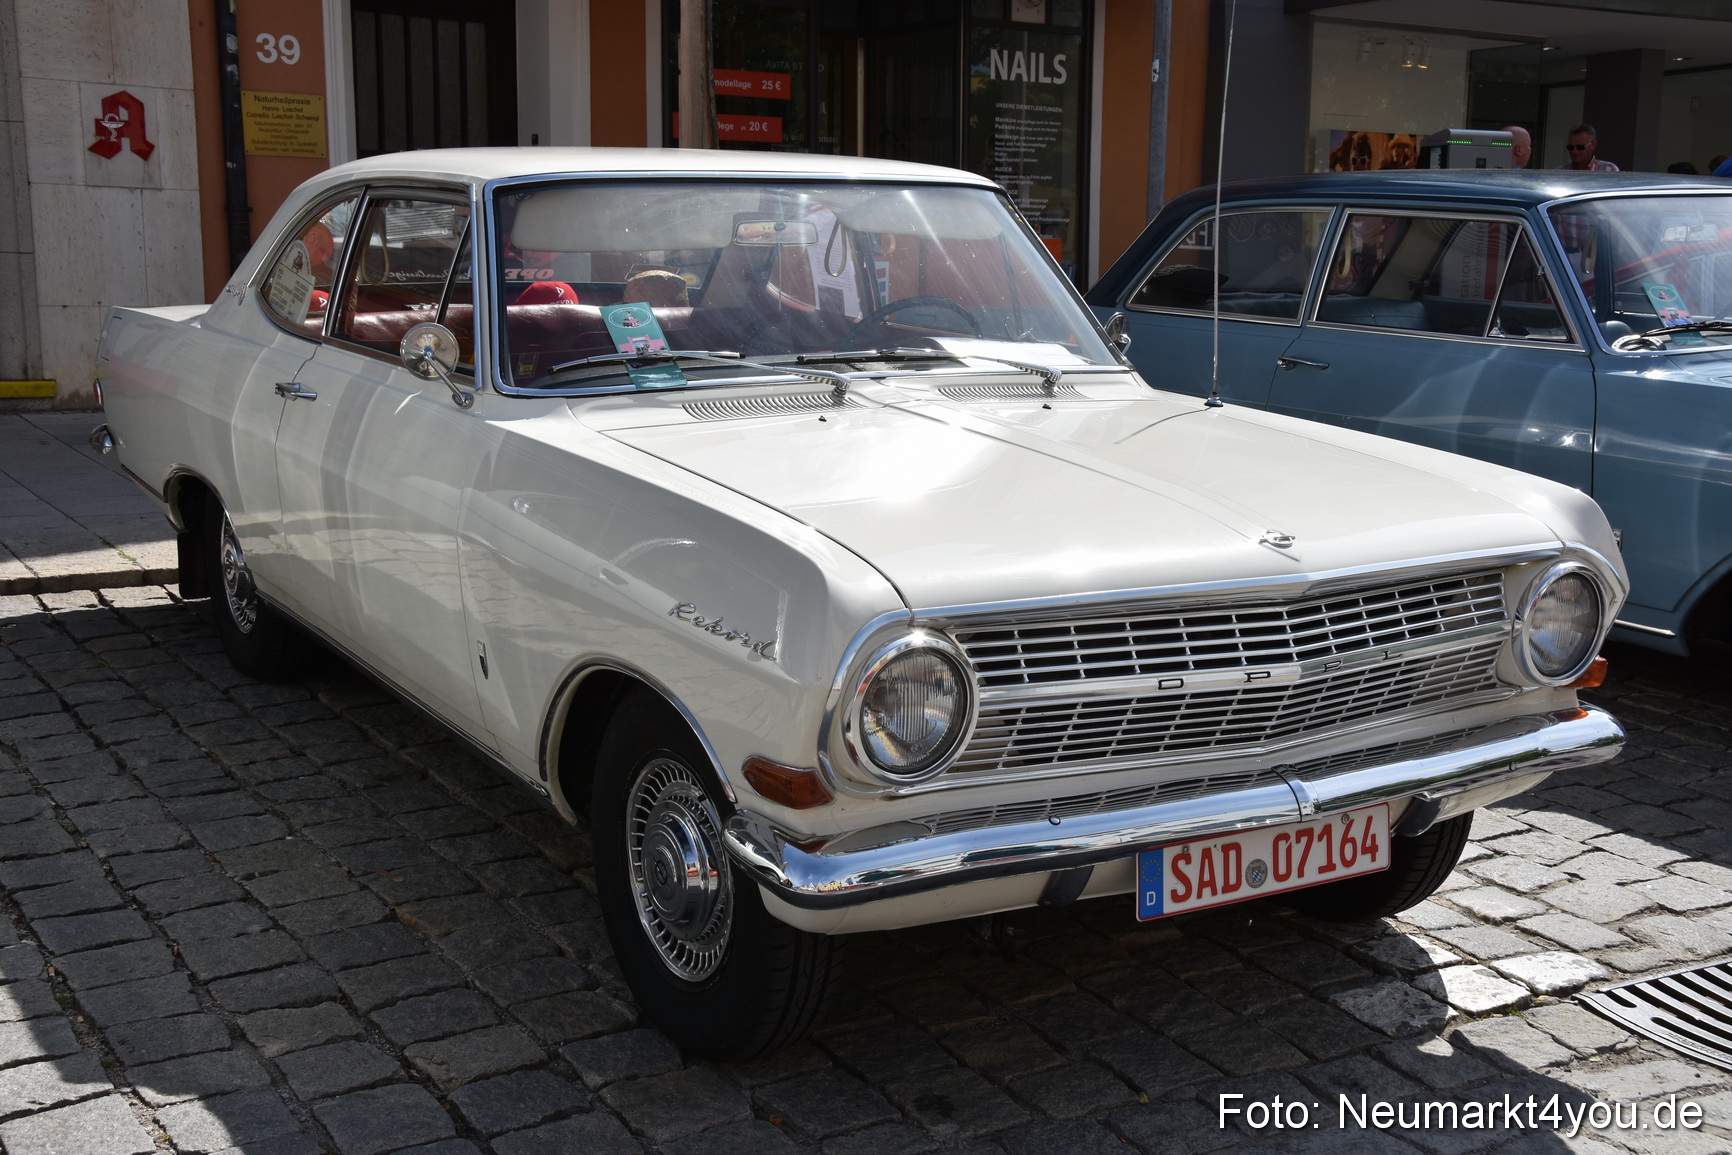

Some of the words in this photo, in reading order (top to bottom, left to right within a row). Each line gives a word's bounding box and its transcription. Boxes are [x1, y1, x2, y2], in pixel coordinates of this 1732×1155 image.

[255, 32, 301, 65] 39
[766, 60, 790, 70] AVITA
[990, 48, 1067, 85] NAILS
[254, 95, 310, 105] Naturheilpraxis
[762, 80, 773, 90] 25
[775, 81, 781, 91] €
[749, 121, 760, 131] 20
[762, 122, 768, 132] €
[668, 602, 776, 662] Rekord
[1158, 650, 1402, 690] OPEL
[1146, 891, 1156, 906] D
[1170, 842, 1242, 903] SAD
[1272, 816, 1378, 882] 07164
